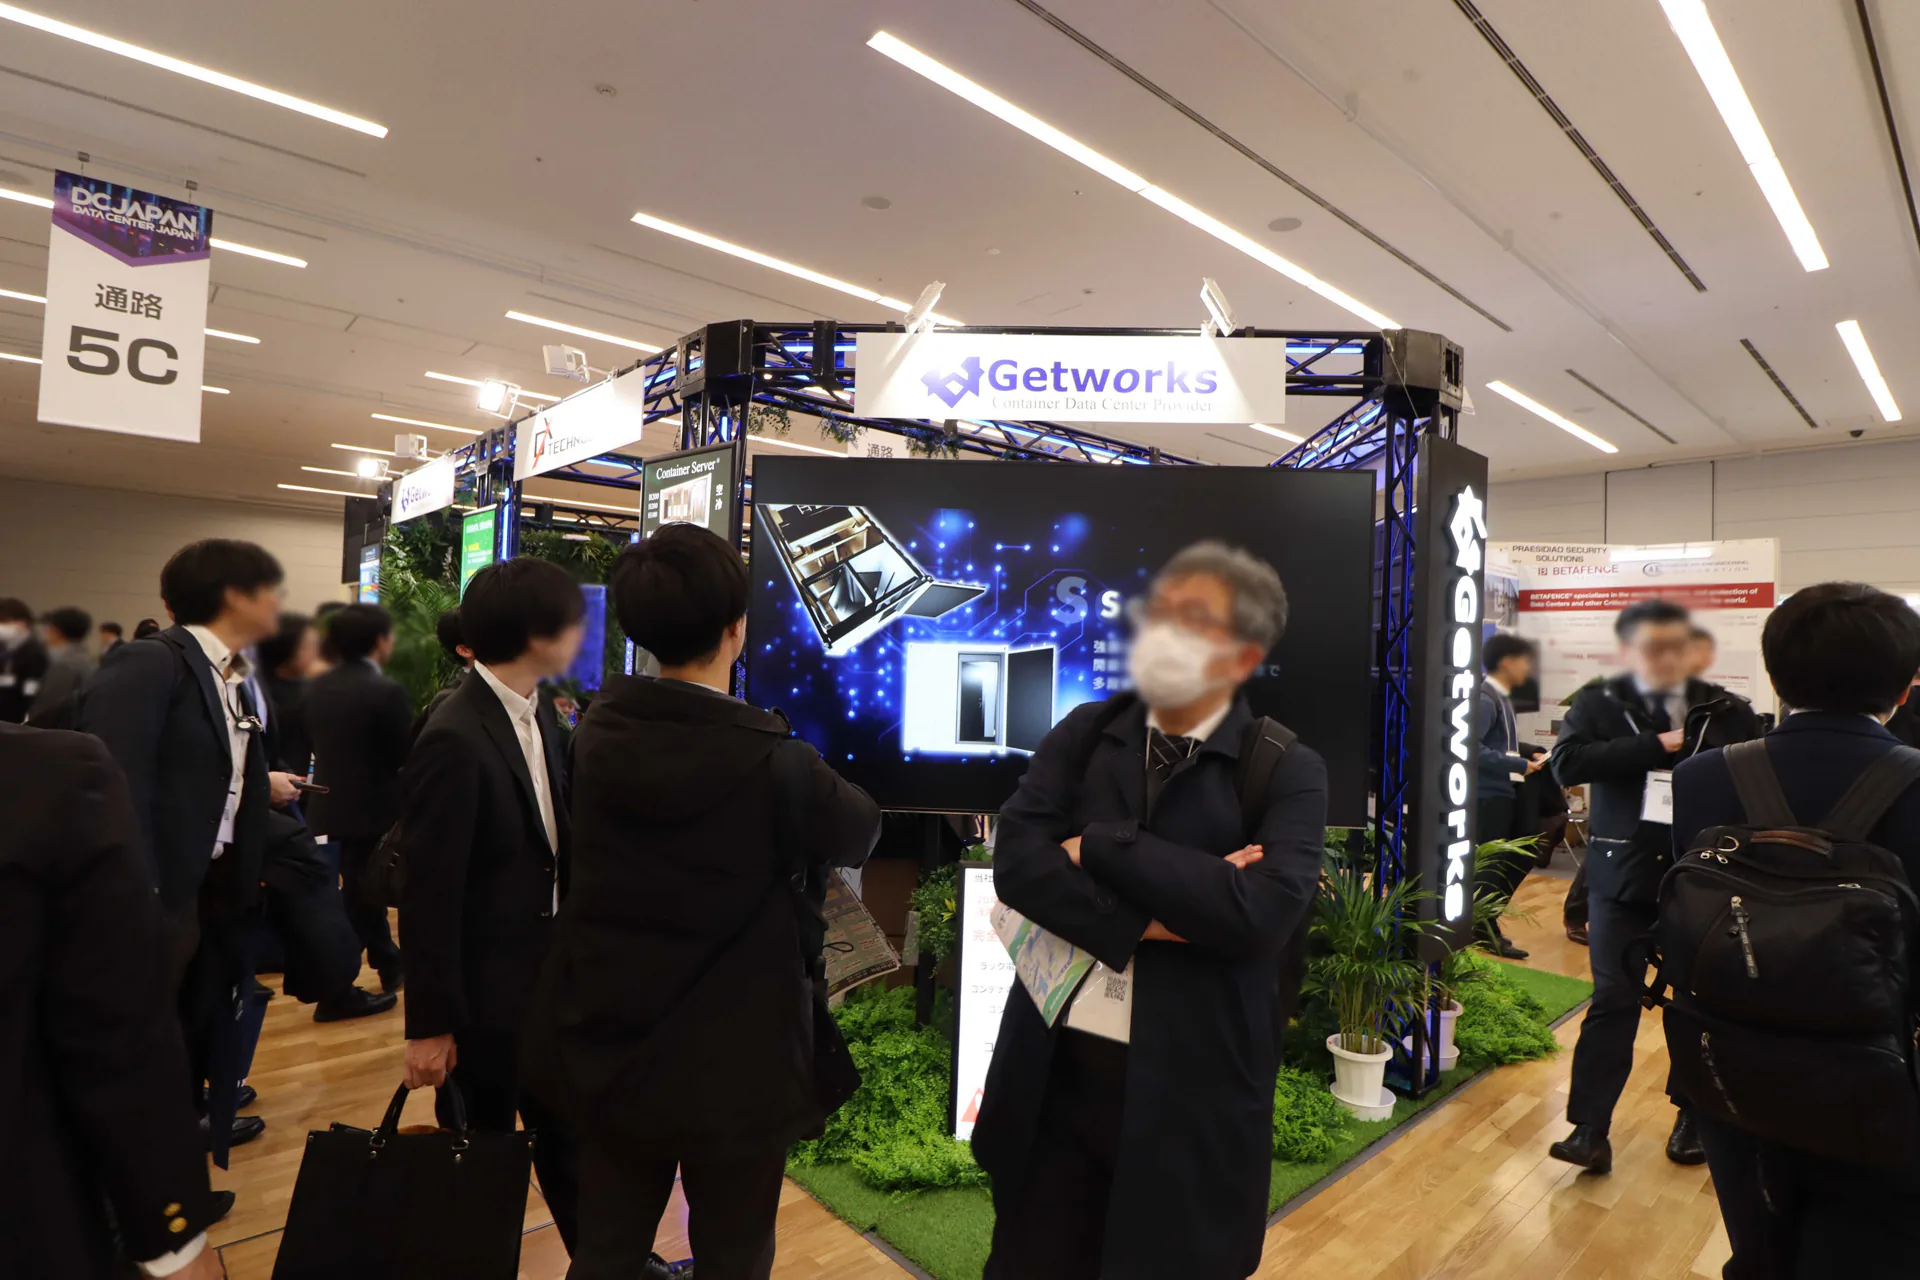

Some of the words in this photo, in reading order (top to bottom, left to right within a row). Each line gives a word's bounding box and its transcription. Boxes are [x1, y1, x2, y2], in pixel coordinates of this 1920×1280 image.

[72, 204, 105, 220] DATA
[105, 212, 155, 232] CENTER
[155, 226, 195, 241] JAPAN
[94, 283, 163, 320] 通路
[66, 324, 179, 386] 5C
[988, 359, 1217, 394] Getworks
[992, 396, 1060, 410] Container
[1065, 397, 1097, 410] Data
[1101, 398, 1148, 411] Center
[1153, 399, 1214, 412] Provider
[867, 442, 893, 458] 通路
[656, 464, 690, 480] Container
[1566, 546, 1607, 554] SECURITY
[1535, 555, 1584, 563] SOLUTIONS
[1552, 564, 1619, 576] BETAFENCE
[1444, 575, 1477, 922] Getworks
